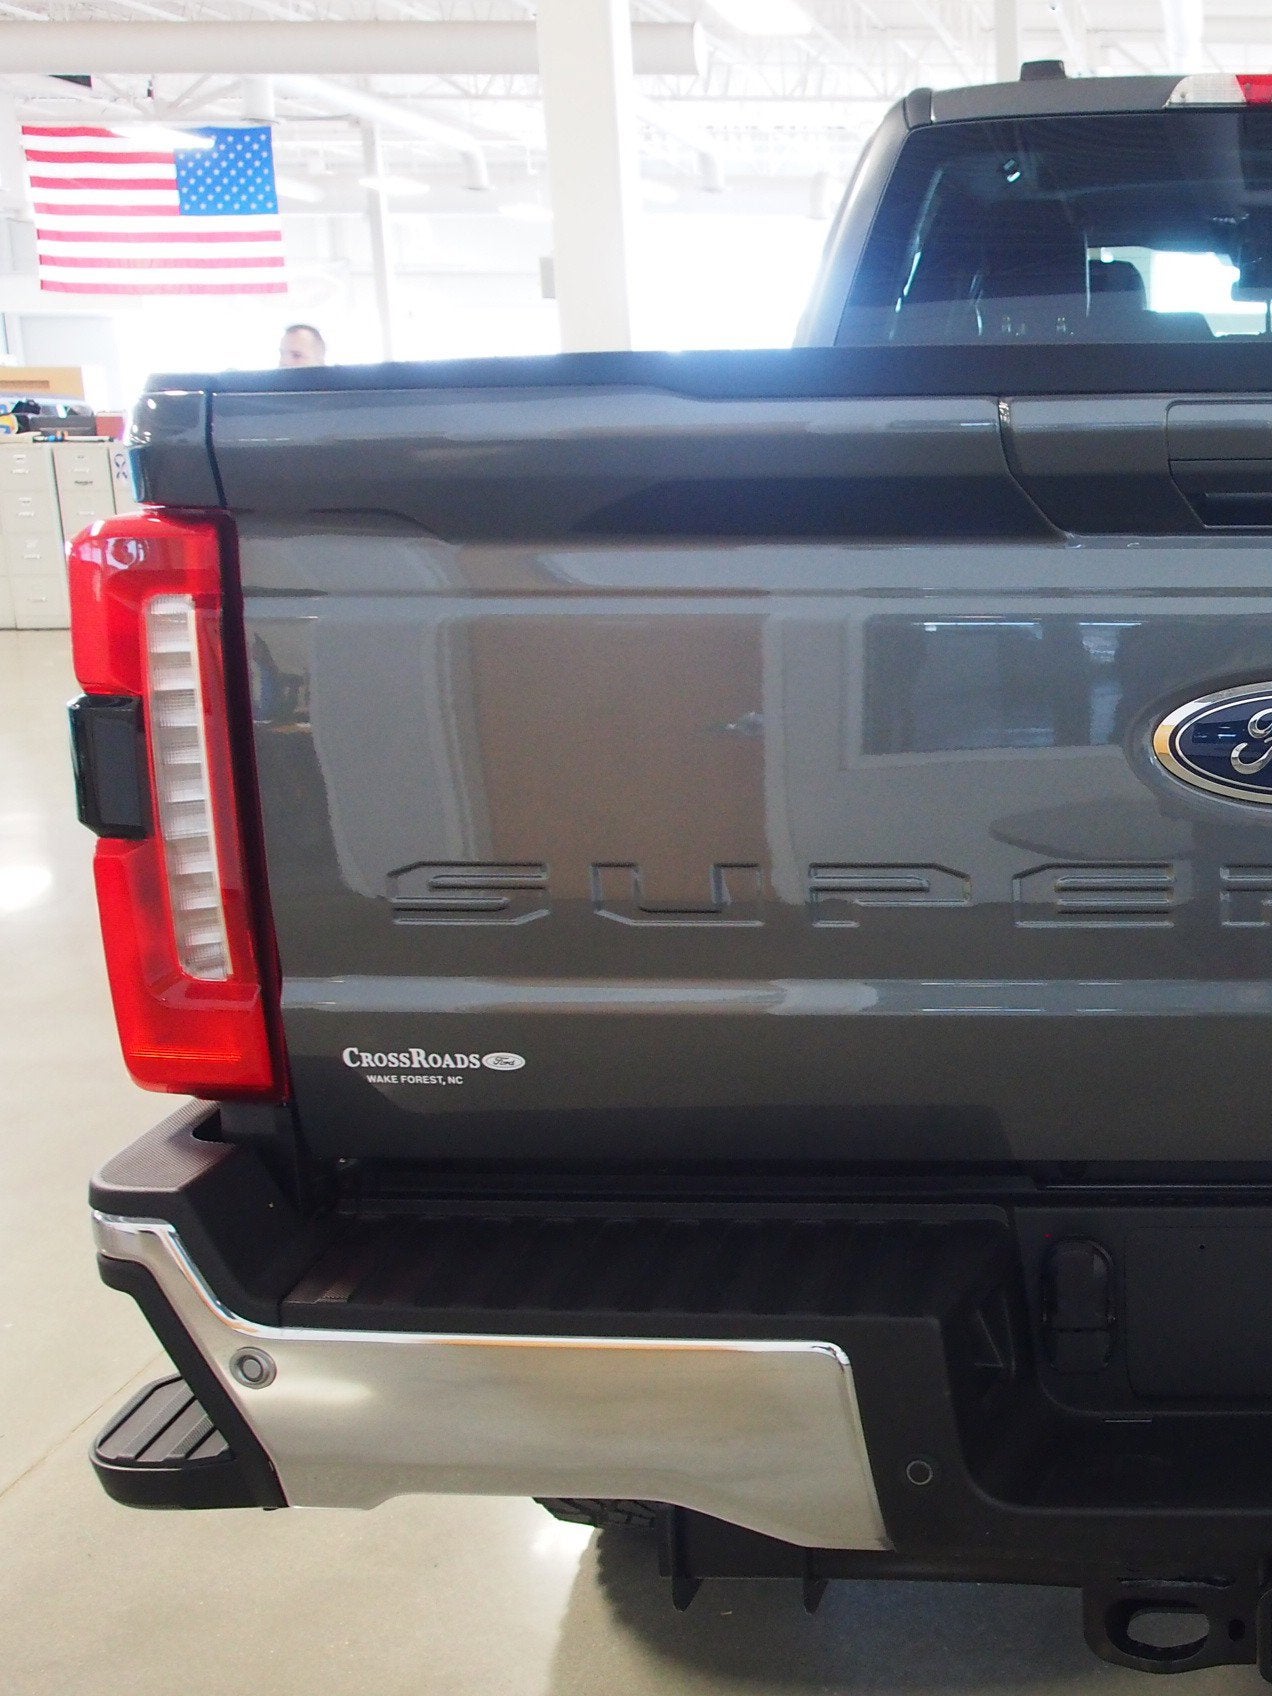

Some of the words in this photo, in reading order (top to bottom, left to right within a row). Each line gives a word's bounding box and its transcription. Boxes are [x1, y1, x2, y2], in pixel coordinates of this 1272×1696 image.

[366, 1074, 399, 1084] WAKE
[401, 1075, 446, 1086] FOREST,
[448, 1076, 463, 1085] NC
